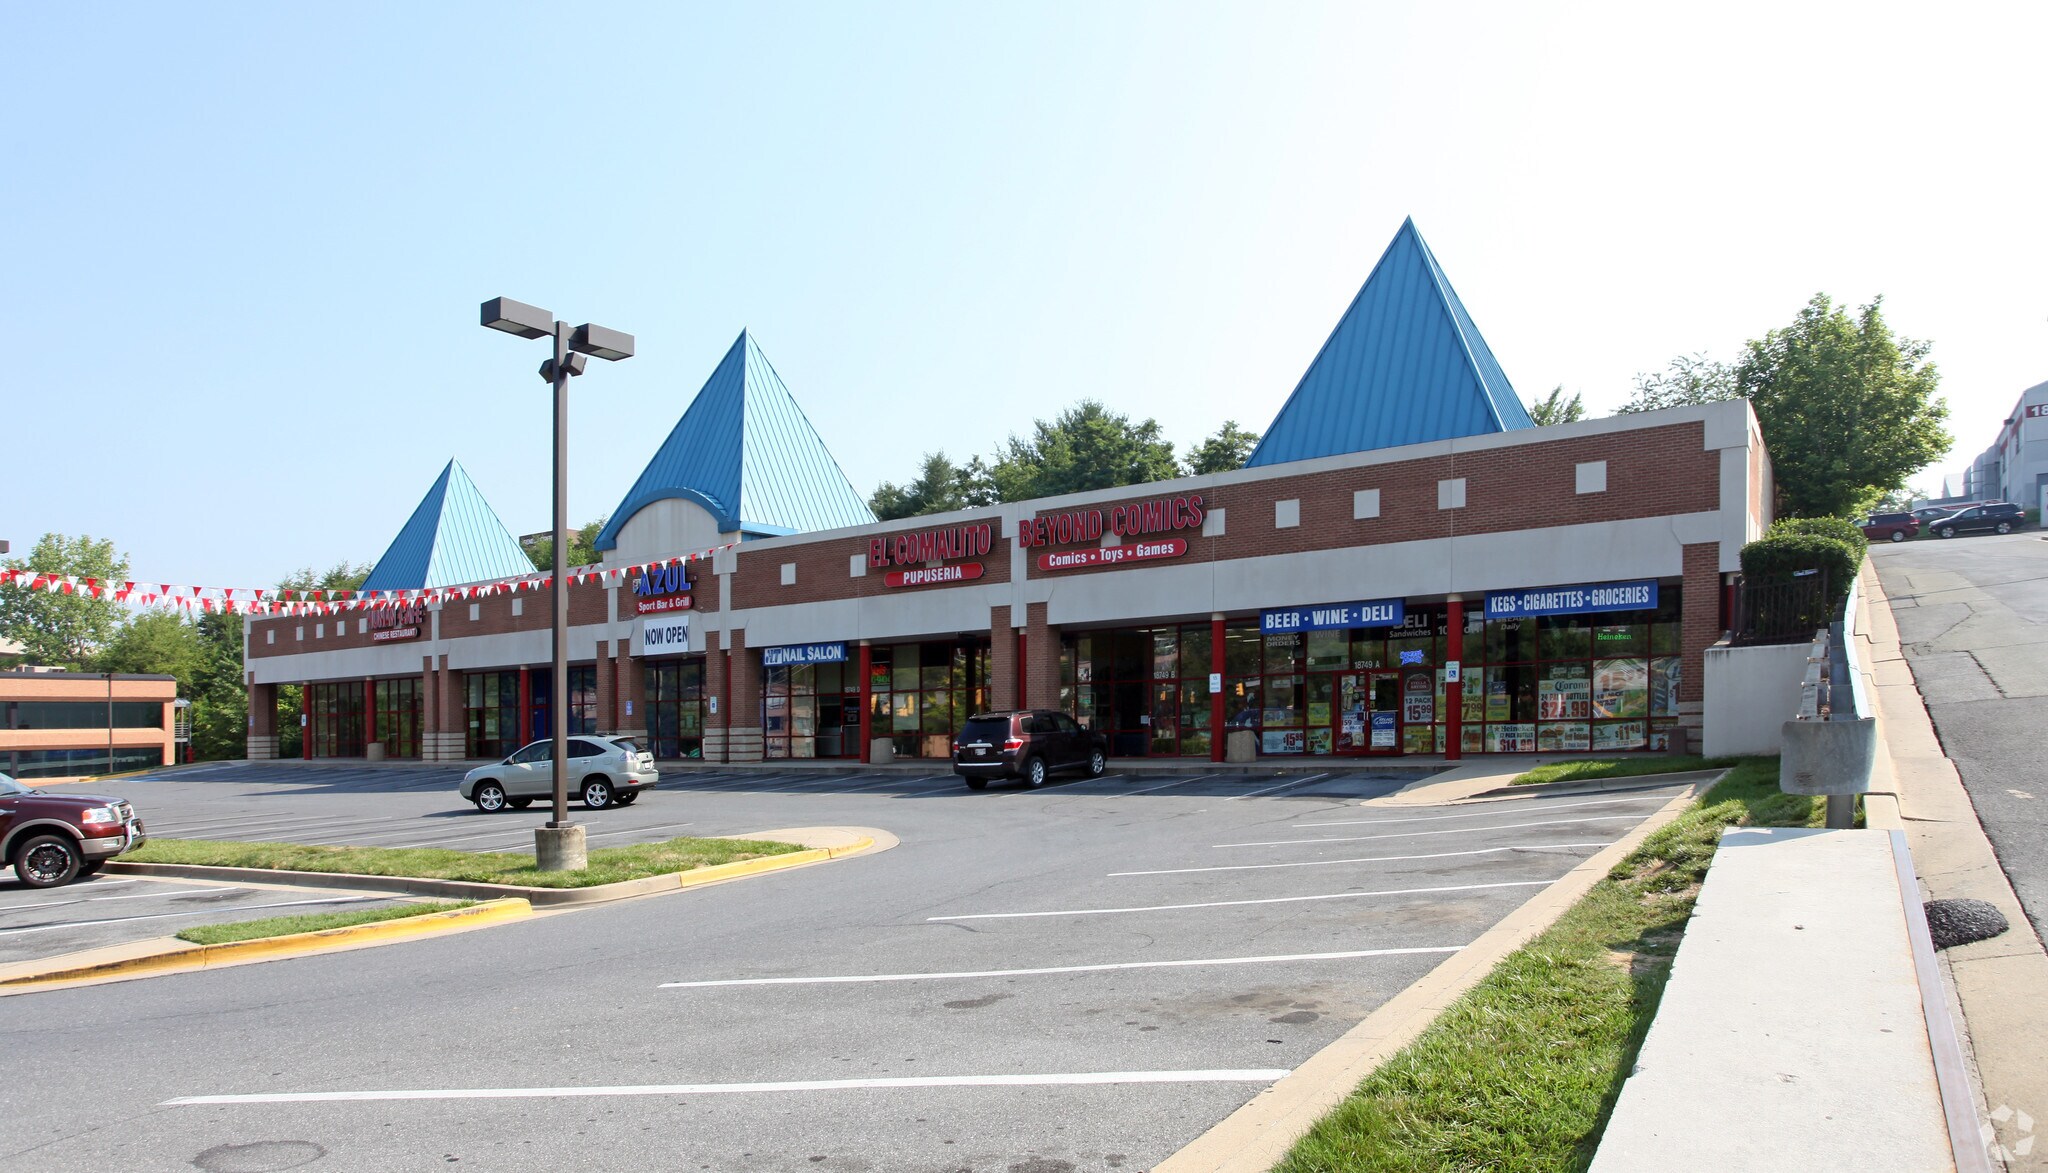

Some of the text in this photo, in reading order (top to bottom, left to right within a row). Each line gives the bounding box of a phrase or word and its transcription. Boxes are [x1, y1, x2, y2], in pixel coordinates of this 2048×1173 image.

[1018, 495, 1204, 548] BEYOND COMICS
[869, 523, 992, 568] EL COMALITO
[1049, 543, 1174, 567] Comics Toys Games
[638, 565, 692, 597] AZUL
[903, 566, 963, 585] PUPUSERIA
[638, 601, 656, 613] Sport
[656, 600, 668, 609] Bar
[675, 596, 690, 607] Grill
[1491, 586, 1650, 613] KEGS CIGARETTES GROCERIES
[1265, 604, 1394, 629] BEER WINE DELI
[1393, 613, 1428, 629] ELI
[1389, 629, 1431, 639] Sandwiches
[1500, 622, 1521, 631] Daily
[645, 625, 688, 646] NOW OPEN
[1266, 634, 1299, 642] MONEY
[1597, 633, 1632, 641] Heineken
[782, 647, 805, 662] NAIL
[807, 645, 842, 661] SALON
[1354, 660, 1380, 669] 18749 A
[1555, 681, 1590, 692] Corona
[1566, 692, 1589, 700] BOTTLES
[1541, 700, 1589, 719] $25.99
